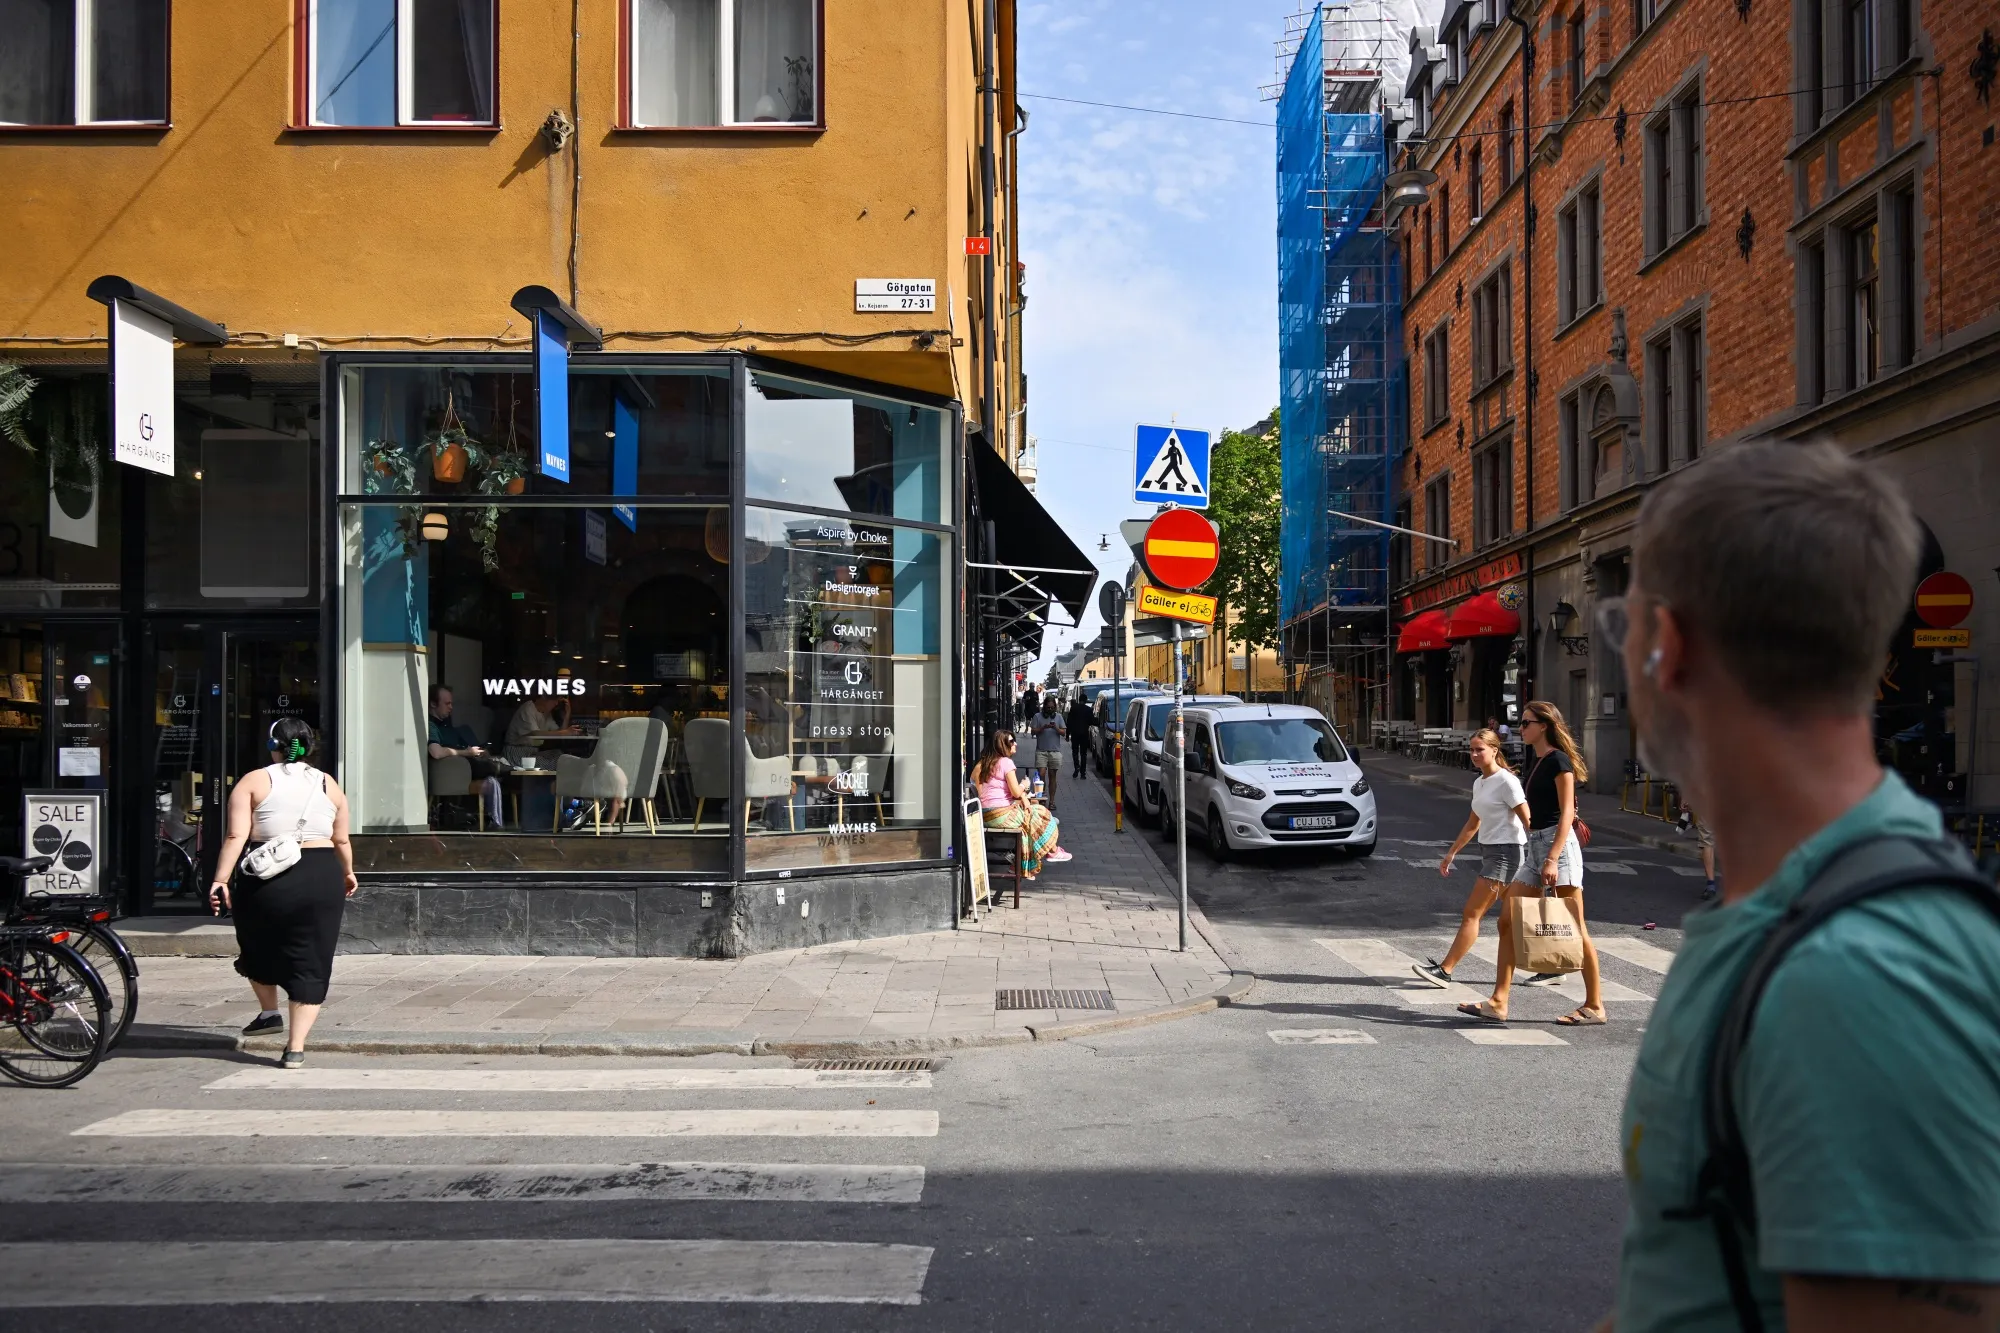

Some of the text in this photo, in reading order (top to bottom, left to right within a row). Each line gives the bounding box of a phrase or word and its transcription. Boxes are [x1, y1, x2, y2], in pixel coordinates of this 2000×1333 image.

[887, 282, 931, 294] Götgatan
[901, 298, 930, 309] 27-31
[545, 452, 566, 472] WAYNES
[817, 526, 888, 543] Aspire by Choke
[1491, 560, 1515, 579] PUB
[825, 580, 880, 597] Designtorget
[1145, 594, 1190, 613] Gäller ej
[1479, 625, 1493, 633] BAR
[483, 678, 586, 696] WAYNES
[821, 688, 884, 700] HÅRGÄNGET
[813, 724, 891, 738] press stop
[836, 772, 869, 789] ROCKET
[39, 805, 85, 822] SALE
[1296, 816, 1333, 827] CUJ 105
[829, 822, 877, 834] WAYNES
[45, 873, 82, 890] REA
[1535, 923, 1572, 931] STOCKHOLMS
